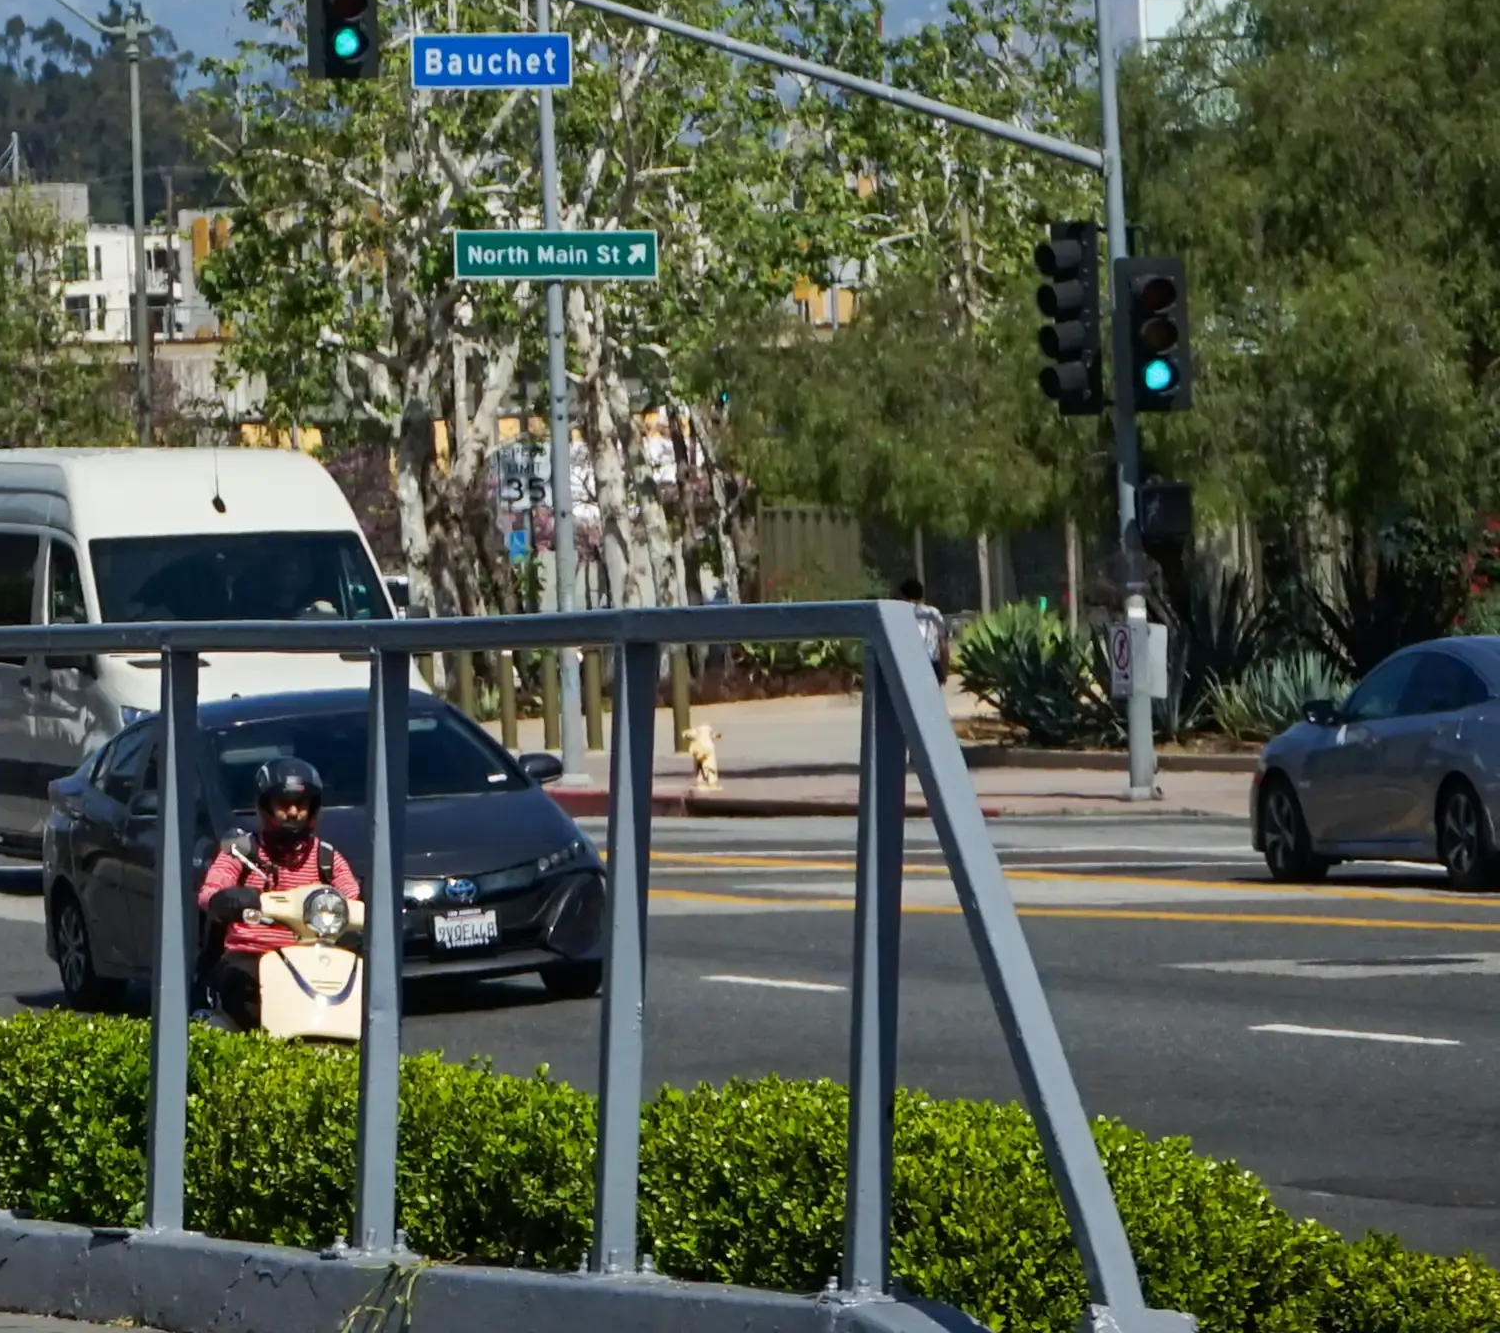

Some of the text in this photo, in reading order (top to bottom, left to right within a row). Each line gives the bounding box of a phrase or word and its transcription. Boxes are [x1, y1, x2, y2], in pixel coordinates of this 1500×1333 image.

[424, 47, 557, 75] Bauchet
[467, 244, 621, 265] North Main St
[500, 478, 546, 502] 35
